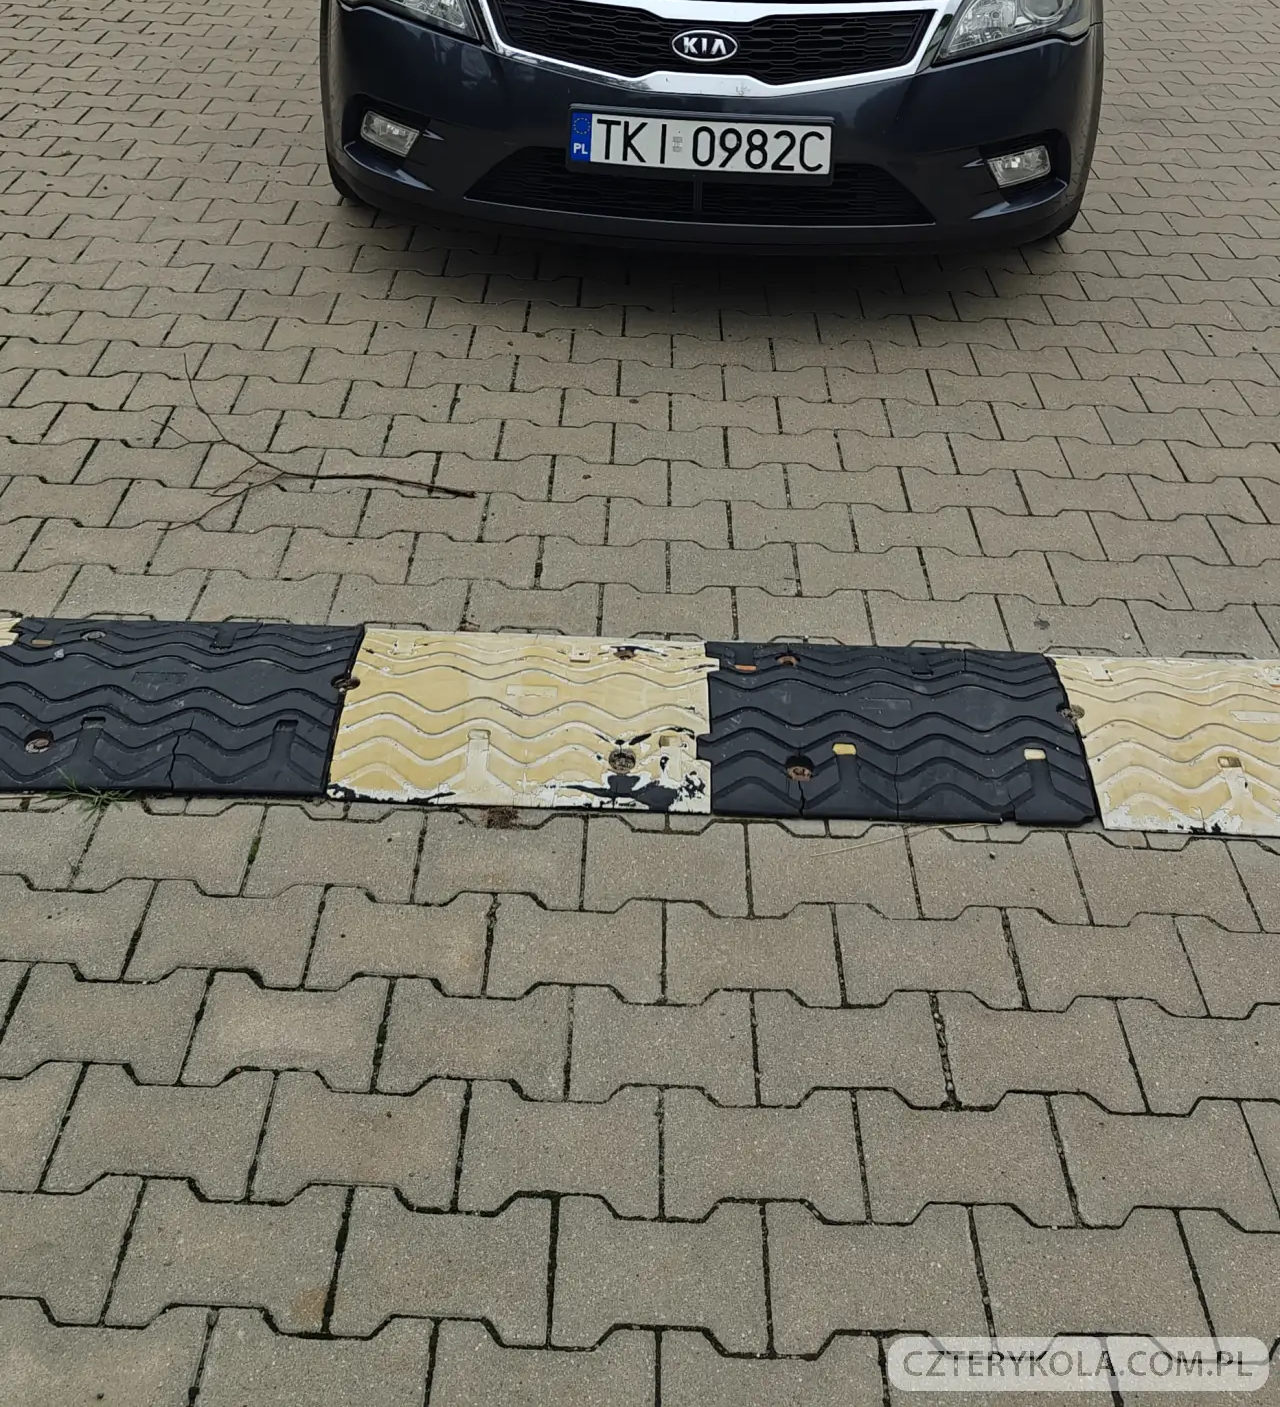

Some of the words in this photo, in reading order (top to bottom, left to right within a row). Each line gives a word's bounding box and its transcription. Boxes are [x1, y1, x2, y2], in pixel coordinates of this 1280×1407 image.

[683, 36, 727, 55] KIA
[573, 142, 588, 155] PL
[597, 118, 667, 165] TKI
[692, 125, 825, 172] 0982C
